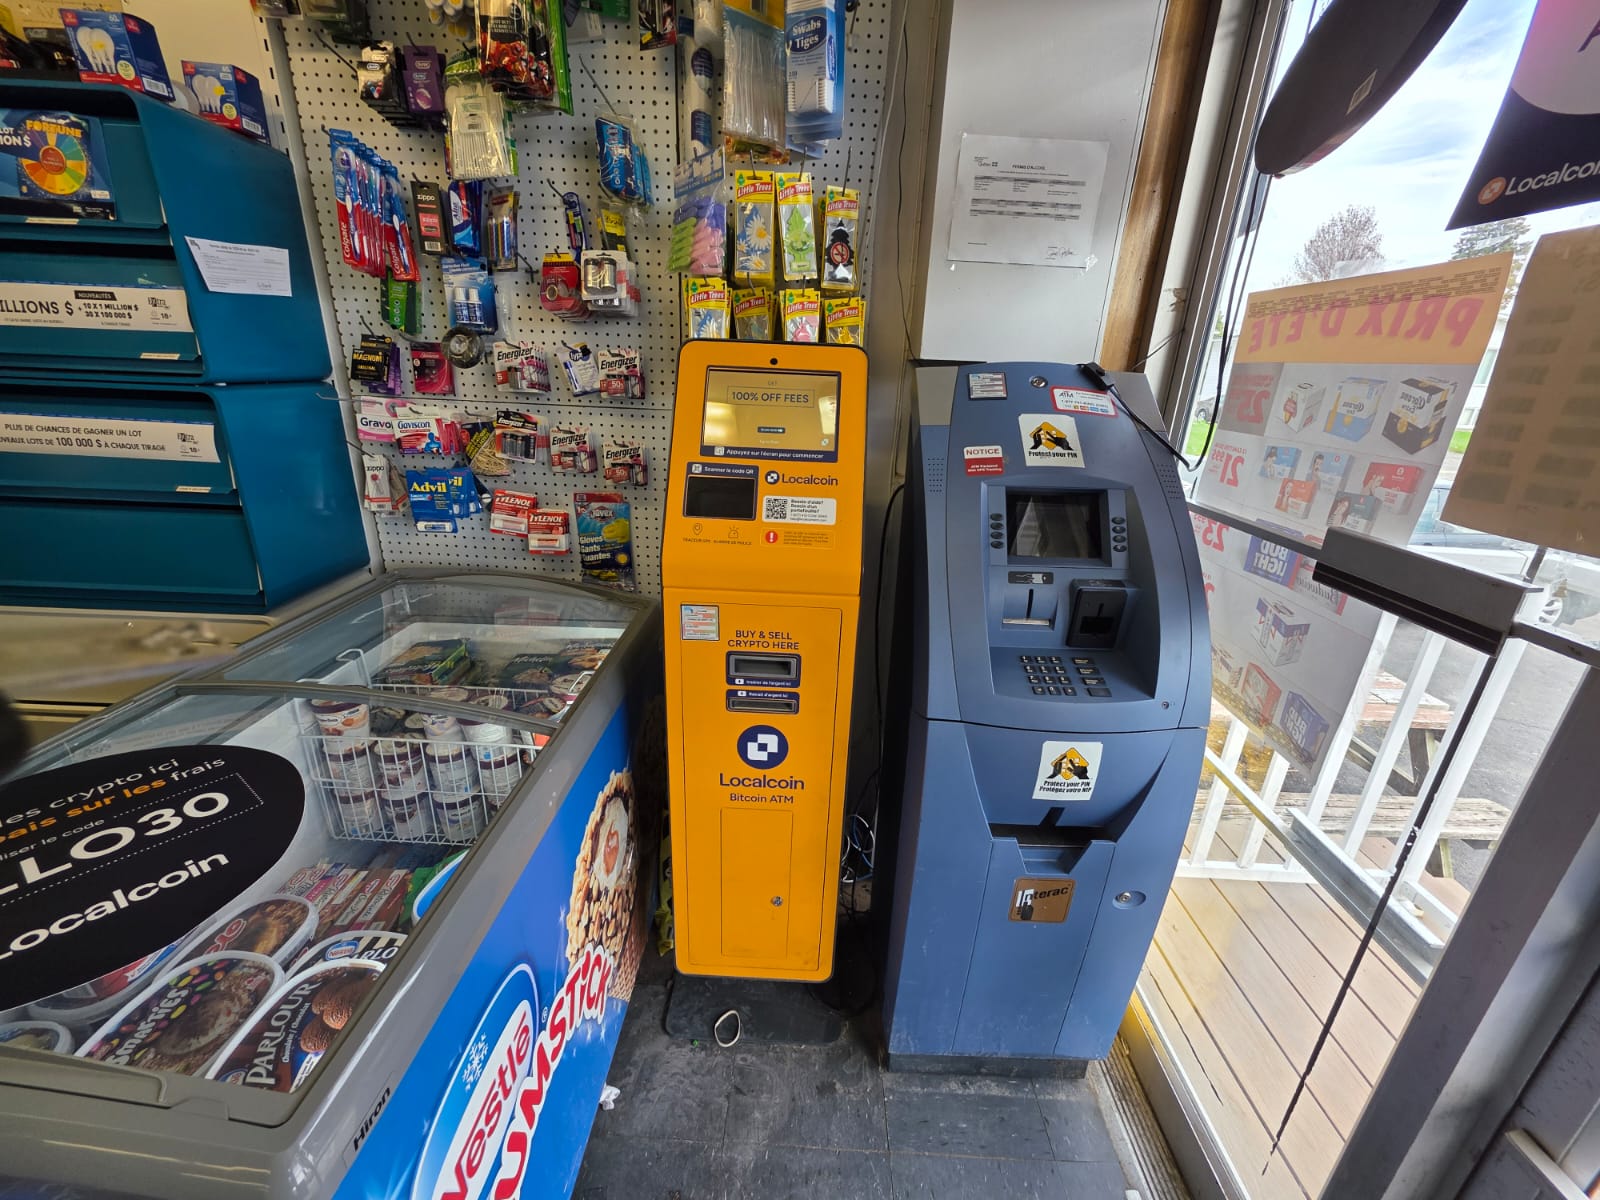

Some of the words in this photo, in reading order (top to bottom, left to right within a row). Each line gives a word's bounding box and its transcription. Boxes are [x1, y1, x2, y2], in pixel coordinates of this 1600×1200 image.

[792, 19, 821, 36] Swabs
[795, 34, 819, 49] Tiges
[26, 119, 83, 138] FORTUNE
[738, 186, 754, 198] Little
[755, 182, 772, 193] Trees
[778, 188, 794, 200] Little
[795, 185, 810, 194] Trees
[827, 202, 842, 211] Little
[842, 201, 857, 209] Trees
[338, 222, 351, 258] Colgate
[388, 241, 401, 274] Colgate
[691, 292, 707, 303] Little
[708, 292, 724, 300] Trees
[64, 301, 74, 316] $
[735, 302, 750, 314] Little
[750, 298, 765, 307] Trees
[788, 303, 803, 313] Little
[803, 302, 818, 310] Trees
[827, 311, 843, 323] Little
[843, 309, 858, 318] Trees
[353, 353, 383, 363] MAGNUM
[497, 345, 533, 361] Energizer
[600, 355, 637, 370] Energizer
[732, 391, 759, 401] 100%
[761, 393, 782, 402] OFF
[783, 394, 809, 403] FEES
[398, 420, 431, 429] Gaviscon
[498, 417, 524, 427] Energizer
[4, 424, 23, 432] PLUS
[36, 426, 70, 434] CHANCES
[83, 428, 114, 436] GAGNER
[26, 438, 44, 446] LOTS
[56, 437, 73, 447] 100
[75, 438, 93, 448] 000
[111, 443, 140, 451] CHAQUE
[552, 432, 587, 446] Energizer
[605, 446, 641, 460] Energizer
[726, 449, 750, 457] Appuyez
[966, 448, 1000, 456] NOTICE
[1028, 450, 1051, 458] Protect
[1051, 451, 1067, 459] your
[410, 481, 447, 493] Advil
[781, 473, 839, 487] Localcoin
[495, 496, 531, 507] TYLENOL
[529, 514, 564, 523] TYLENOL
[580, 536, 603, 544] Gloves
[580, 545, 600, 553] Gants
[581, 553, 612, 561] Guantes
[735, 630, 757, 638] BUY
[758, 630, 766, 639] &
[768, 631, 792, 640] SELL
[727, 639, 770, 649] CRYPTO
[772, 641, 800, 650] HERE
[49, 772, 143, 810] crypto
[150, 758, 180, 774] ici
[66, 796, 116, 818] sur
[122, 778, 167, 798] les
[170, 758, 225, 781] frais
[719, 773, 805, 790] Localcoin
[729, 793, 767, 804] Bitcoin
[769, 794, 794, 804] ATM
[41, 835, 57, 846] le
[62, 818, 105, 838] code
[1018, 885, 1070, 906] Interac
[245, 981, 322, 1085] PARLOUR
[440, 1010, 531, 1200] Nestlé
[353, 1087, 391, 1152] Hiron
